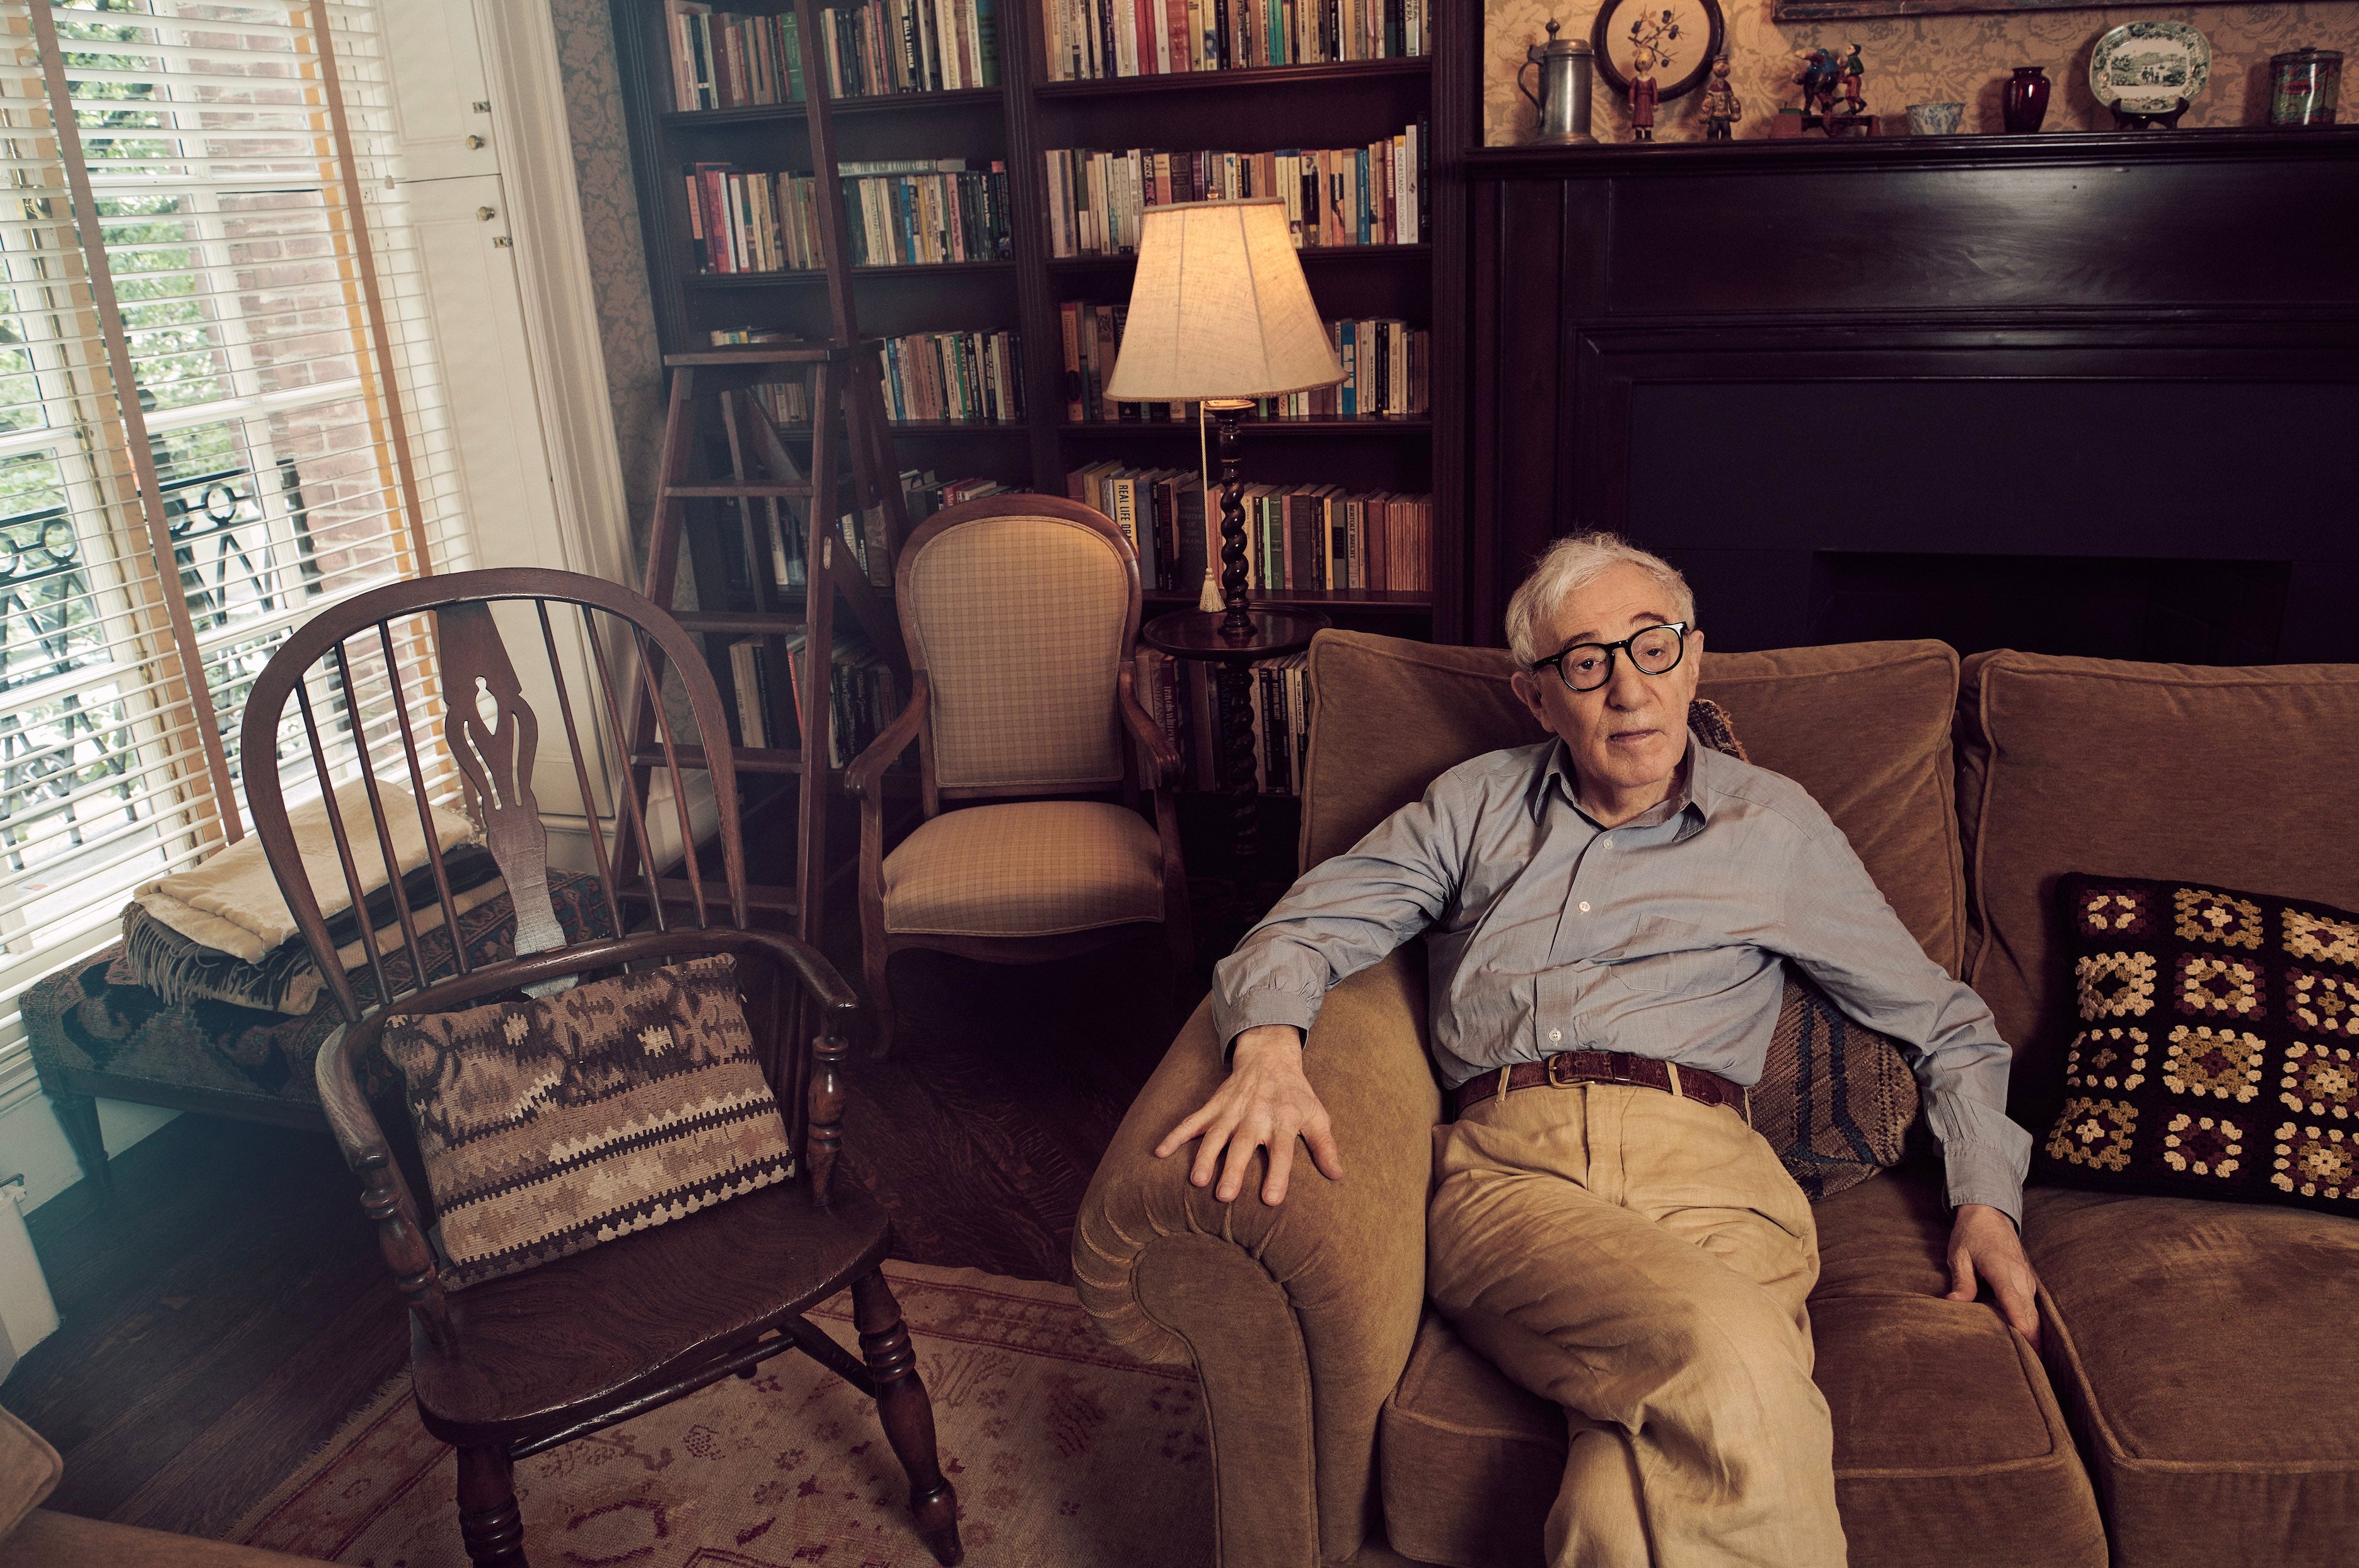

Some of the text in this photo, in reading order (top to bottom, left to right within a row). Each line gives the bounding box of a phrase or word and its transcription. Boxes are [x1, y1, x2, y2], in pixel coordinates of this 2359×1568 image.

[1118, 485, 1129, 503] REAL
[1120, 506, 1130, 521] LIFE
[843, 693, 851, 718] Brothers
[1154, 669, 1164, 723] DOROTHY AND
[1164, 686, 1174, 712] Travels
[1220, 674, 1231, 719] MARTHA
[1166, 713, 1176, 729] with
